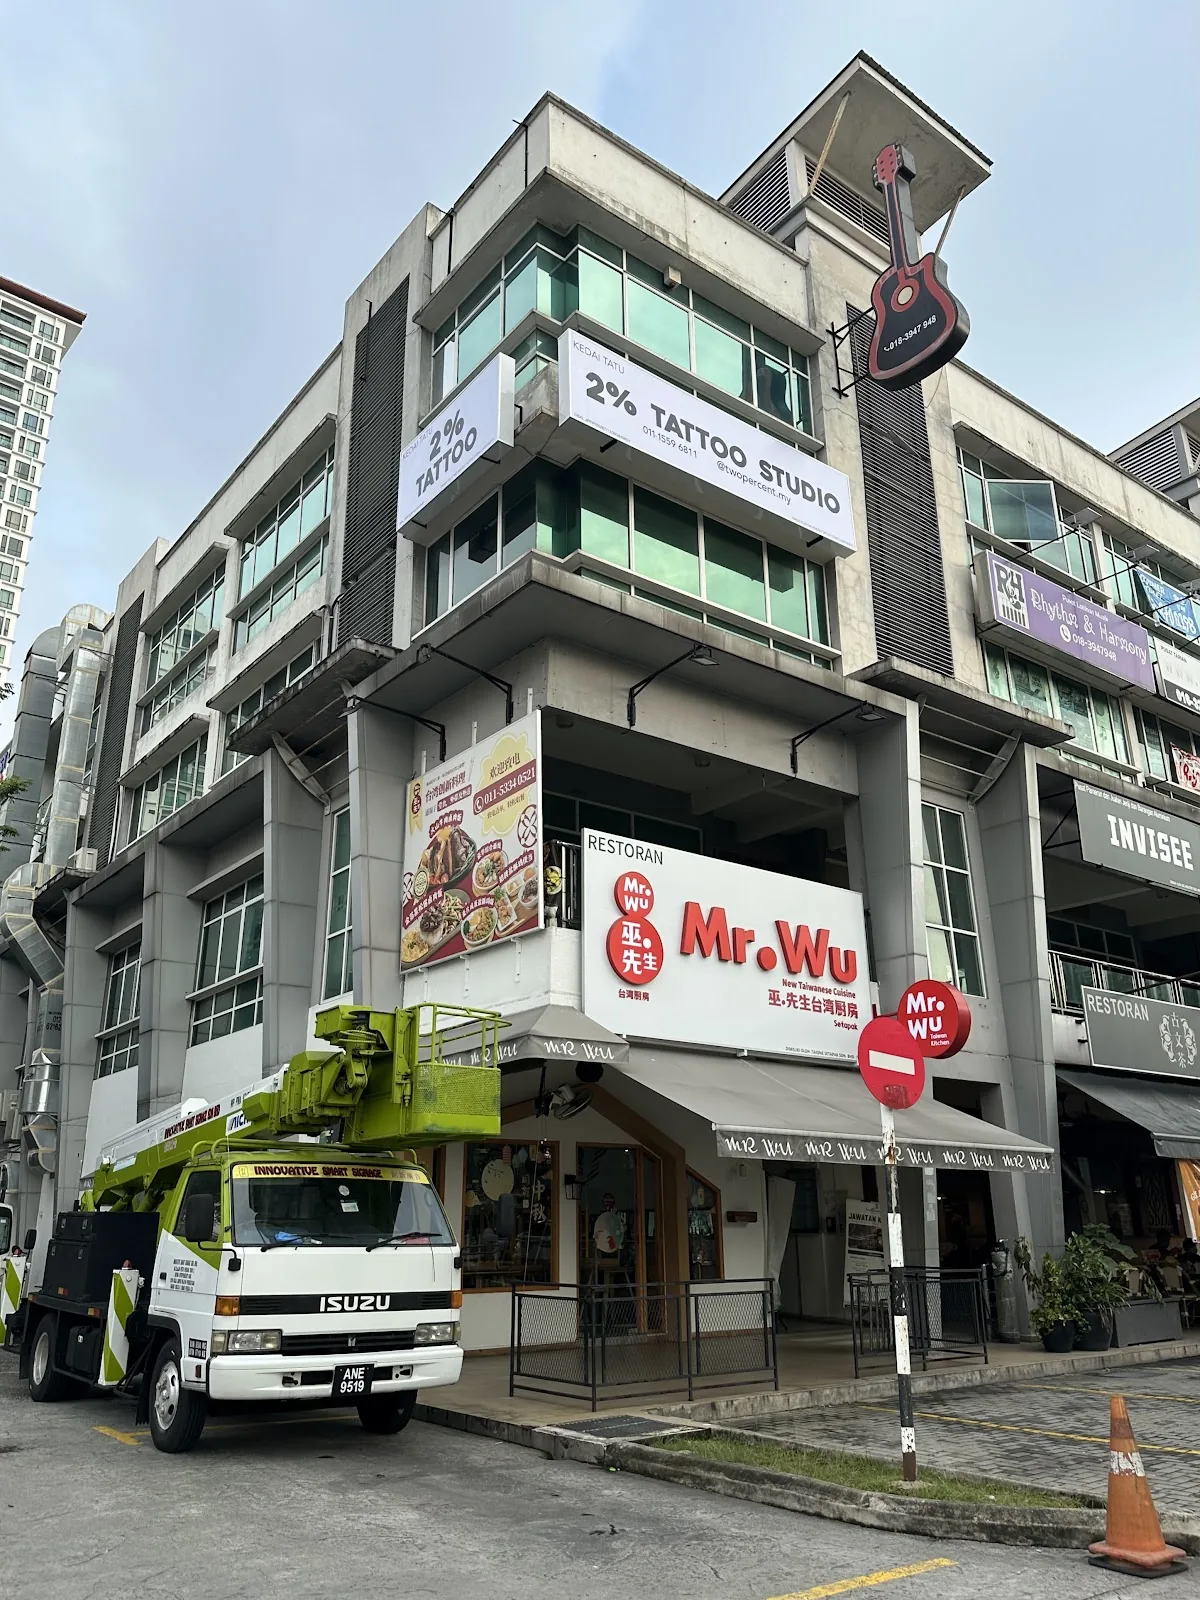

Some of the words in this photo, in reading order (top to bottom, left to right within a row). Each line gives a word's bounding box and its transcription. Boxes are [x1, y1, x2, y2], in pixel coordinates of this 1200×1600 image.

[889, 324, 922, 350] 018-3947
[922, 314, 937, 329] 948
[573, 340, 601, 362] KEDAI
[602, 356, 625, 375] TATU
[429, 408, 465, 462] 2%
[585, 371, 637, 416] 2%
[650, 402, 747, 468] TATTOO
[758, 459, 841, 514] STUDIO
[642, 425, 676, 448] 011-1559
[678, 442, 698, 458] 6811
[415, 426, 478, 498] TATTOO
[716, 460, 792, 506] @twopercent.my
[1030, 588, 1079, 629] Rhythm
[1083, 614, 1095, 636] &
[1098, 621, 1147, 665] Harmony
[1072, 633, 1118, 662] 018-3947948
[489, 752, 521, 780] 欢迎致电
[425, 770, 466, 804] 台湾创新料理
[484, 777, 517, 805] 011-5334
[517, 766, 536, 786] 0521
[588, 834, 663, 865] RESTORAN
[1107, 814, 1194, 871] INVISEE
[623, 876, 652, 897] Mr.
[624, 895, 649, 912] Wu
[622, 949, 658, 975] 先生
[618, 988, 650, 1002] 台湾厨房
[782, 978, 797, 989] New
[798, 981, 832, 995] Taiwanese
[833, 988, 856, 999] Cuisine
[906, 991, 945, 1015] Mr.
[1087, 993, 1150, 1022] RESTORAN
[834, 1019, 858, 1031] Setapak
[930, 1039, 950, 1047] Kitchen
[254, 1166, 320, 1176] INNOVATIVE
[322, 1167, 348, 1177] SMART
[351, 1168, 383, 1178] SIGNAGE
[848, 1212, 877, 1222] JAWATAN
[319, 1295, 391, 1312] ISUZU
[340, 1380, 364, 1393] 9519
[343, 1367, 365, 1380] ANE
